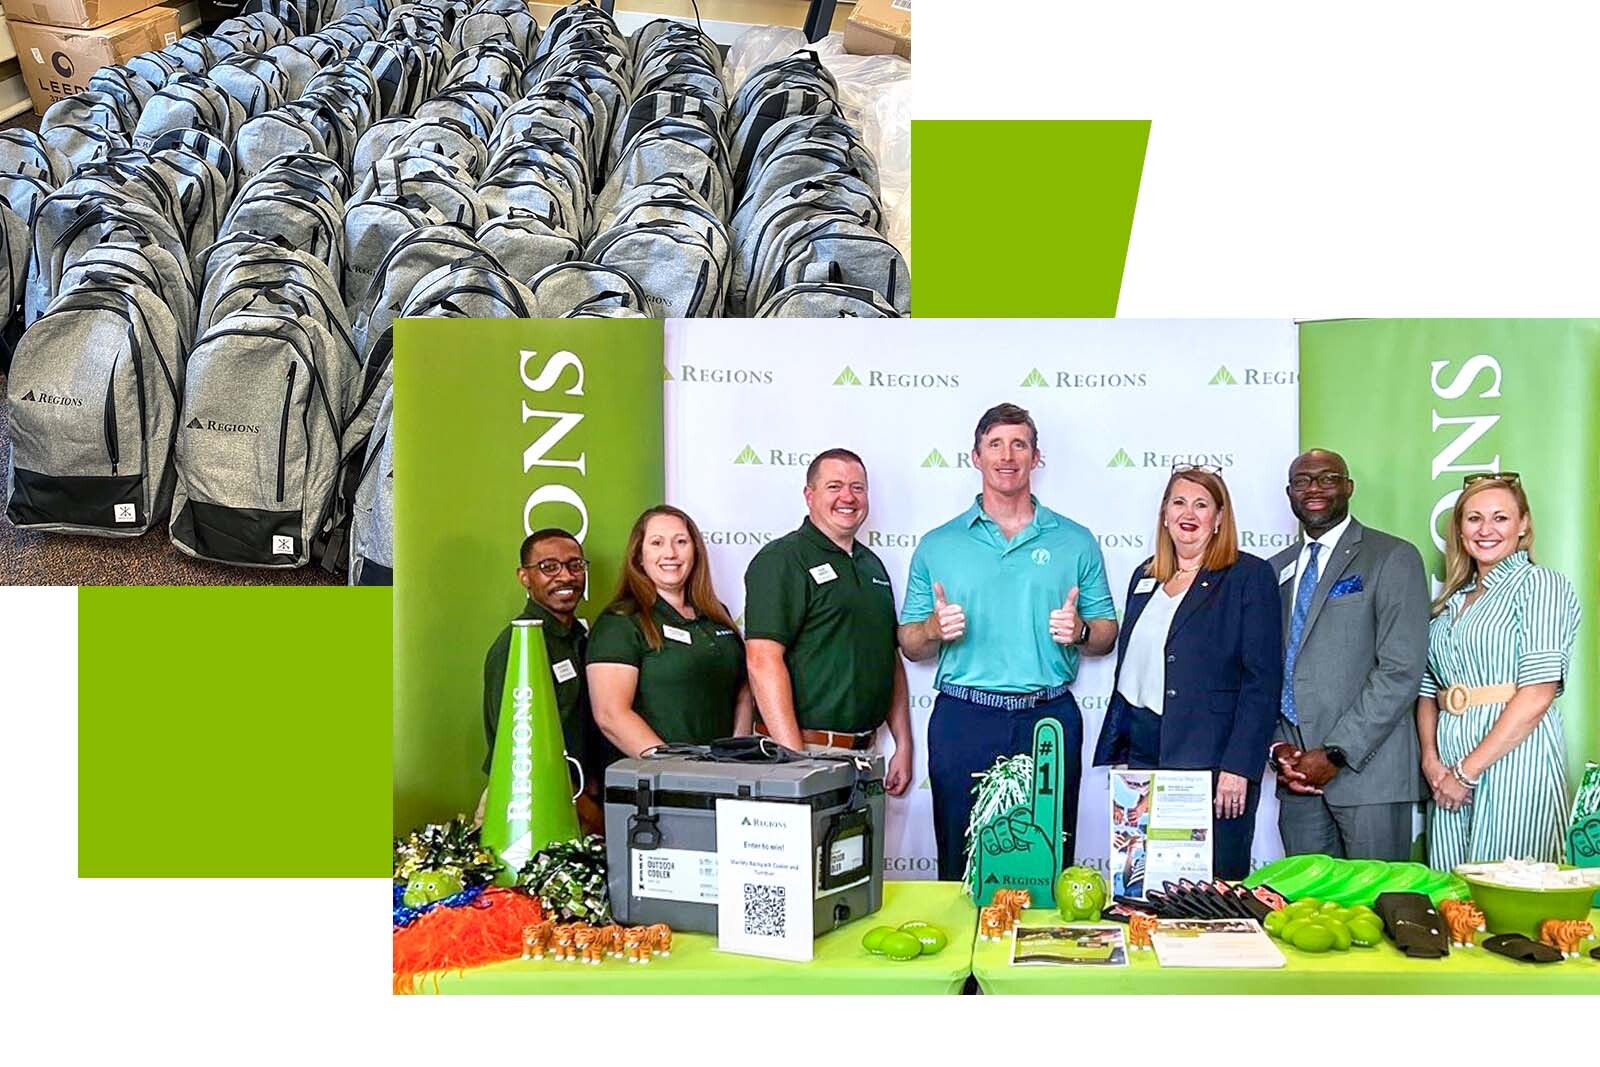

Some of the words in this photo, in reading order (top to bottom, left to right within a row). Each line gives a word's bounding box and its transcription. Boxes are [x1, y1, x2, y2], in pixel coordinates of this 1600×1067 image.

[646, 294, 674, 307] GIONS
[681, 365, 773, 385] REGIONS
[868, 371, 960, 388] REGIONS
[1055, 371, 1147, 388] REGIONS
[1244, 368, 1300, 385] REGI
[38, 392, 83, 407] REGIONS
[207, 420, 260, 434] REGIONS
[701, 531, 772, 545] EGIONS
[868, 531, 917, 548] REGI
[1241, 530, 1299, 547] REGI
[507, 687, 533, 822] REGIONS
[1039, 741, 1053, 756] #
[1039, 762, 1053, 795] 1
[883, 857, 938, 871] EGION
[648, 870, 671, 879] COOLER
